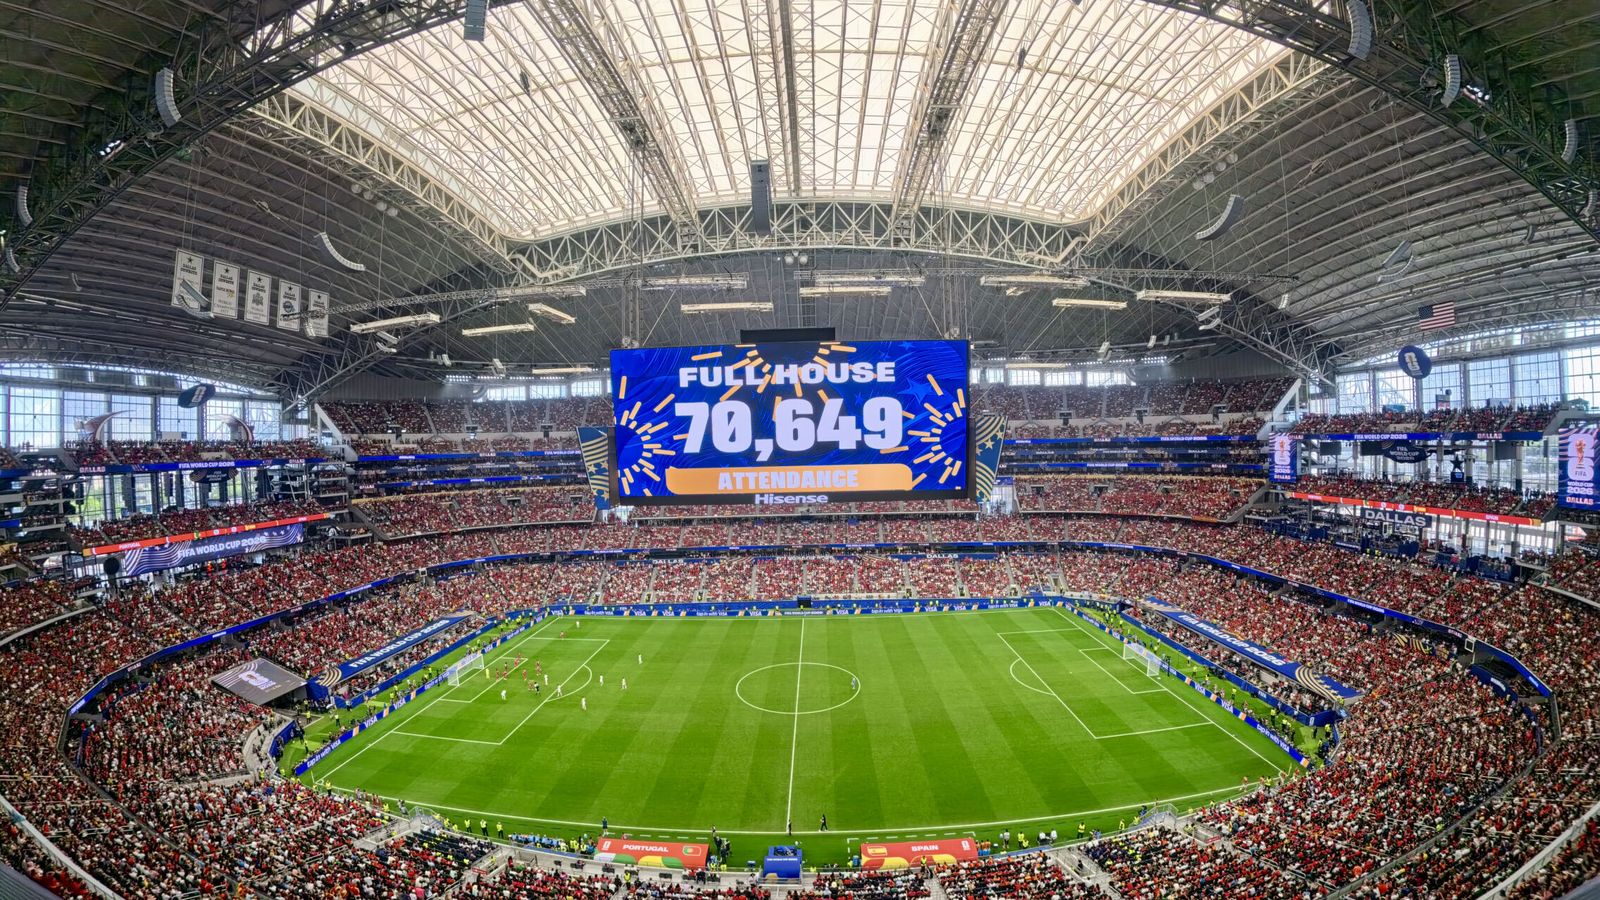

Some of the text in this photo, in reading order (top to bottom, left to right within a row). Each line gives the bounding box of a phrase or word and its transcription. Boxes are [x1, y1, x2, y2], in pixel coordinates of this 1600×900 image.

[679, 362, 896, 388] FULL HOUSE
[674, 396, 902, 462] 70,649
[718, 470, 859, 490] ATTENDANCE
[755, 494, 828, 505] Hisense
[1566, 486, 1594, 495] 2026
[1566, 496, 1594, 505] DALLAS
[1365, 510, 1426, 526] DALLAS
[178, 536, 266, 558] FIFA WORLD CUP 2026
[349, 620, 450, 668] FIFA WORLD CUP 2026
[1178, 614, 1286, 666] FIFA WORLD CUP 2026
[1195, 682, 1205, 692] VISA
[393, 699, 406, 709] VISA
[1221, 700, 1233, 713] VISA
[365, 715, 377, 727] VISA
[1257, 724, 1266, 734] tap
[1270, 733, 1280, 744] with
[1280, 741, 1289, 752] VISA
[307, 759, 316, 768] tap
[320, 748, 331, 758] with
[332, 739, 341, 749] VISA
